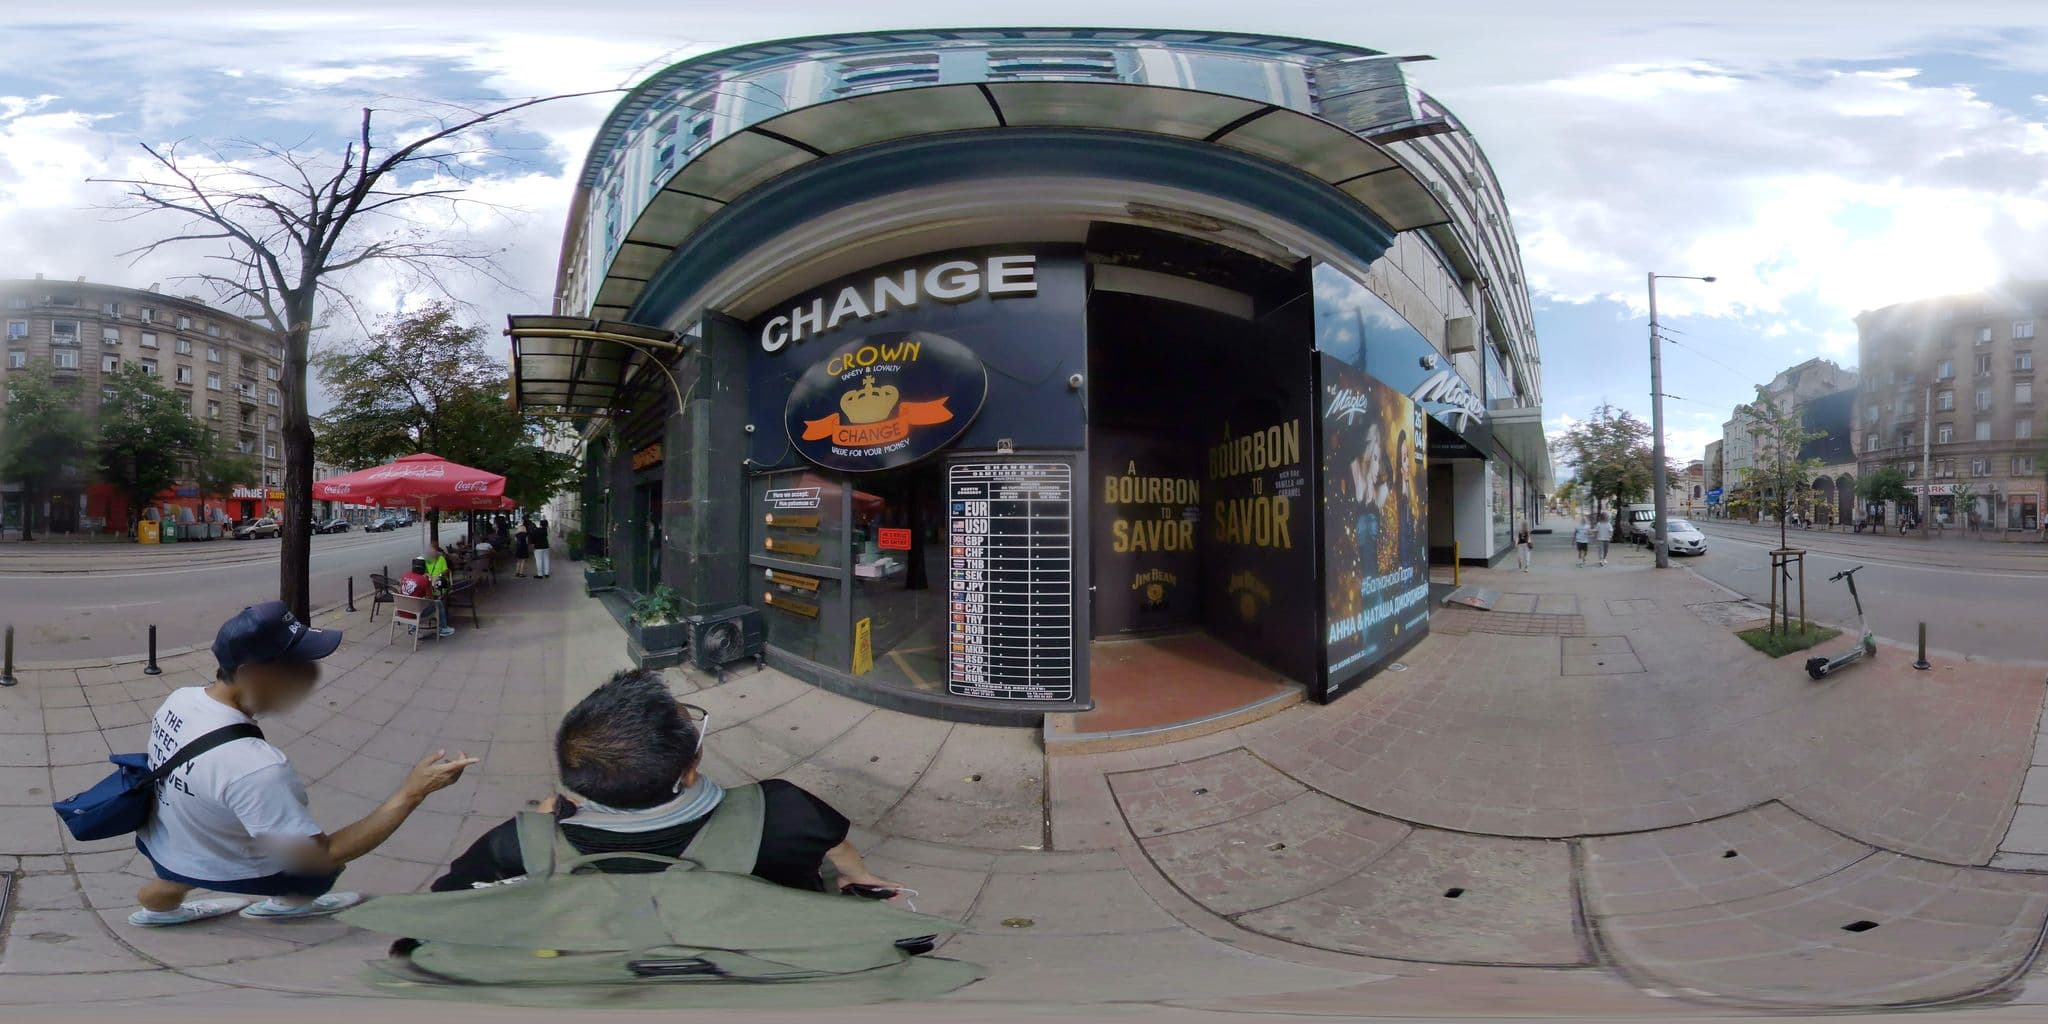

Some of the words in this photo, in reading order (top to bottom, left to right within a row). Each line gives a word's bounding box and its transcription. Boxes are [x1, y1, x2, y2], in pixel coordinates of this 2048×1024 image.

[761, 255, 1038, 352] CHANGE
[827, 342, 921, 376] CROWN
[873, 364, 901, 373] LOYALTY
[838, 422, 901, 443] CHANGE
[849, 449, 863, 457] FOR
[863, 447, 882, 457] YOUR
[884, 438, 910, 453] MONEY
[1209, 419, 1300, 479] BOURBON
[1128, 460, 1136, 475] A
[1104, 475, 1200, 504] BOURBON
[1252, 477, 1263, 495] TO
[965, 502, 987, 516] EUR
[1161, 507, 1171, 519] TO
[965, 519, 987, 534] USD
[1215, 496, 1292, 549] SAVOR
[965, 536, 984, 546] GBP
[1113, 520, 1194, 553] SAVOR
[965, 547, 984, 557] CHF
[965, 560, 984, 569] THB
[965, 570, 983, 580] SEK
[1131, 572, 1151, 590] JIM
[1151, 568, 1177, 586] BEAM
[965, 582, 984, 591] JPY
[965, 594, 984, 603] AUD
[965, 604, 984, 613] CAD
[965, 615, 983, 624] TRY
[1328, 617, 1356, 645] АННА
[1357, 613, 1363, 631] &
[1363, 600, 1394, 627] НАТАША
[965, 625, 984, 634] RON
[965, 635, 982, 645] PLN
[965, 645, 983, 654] MKD
[965, 655, 983, 664] RSD
[965, 664, 983, 674] CZK
[965, 674, 983, 683] RUB
[164, 710, 183, 733] THE
